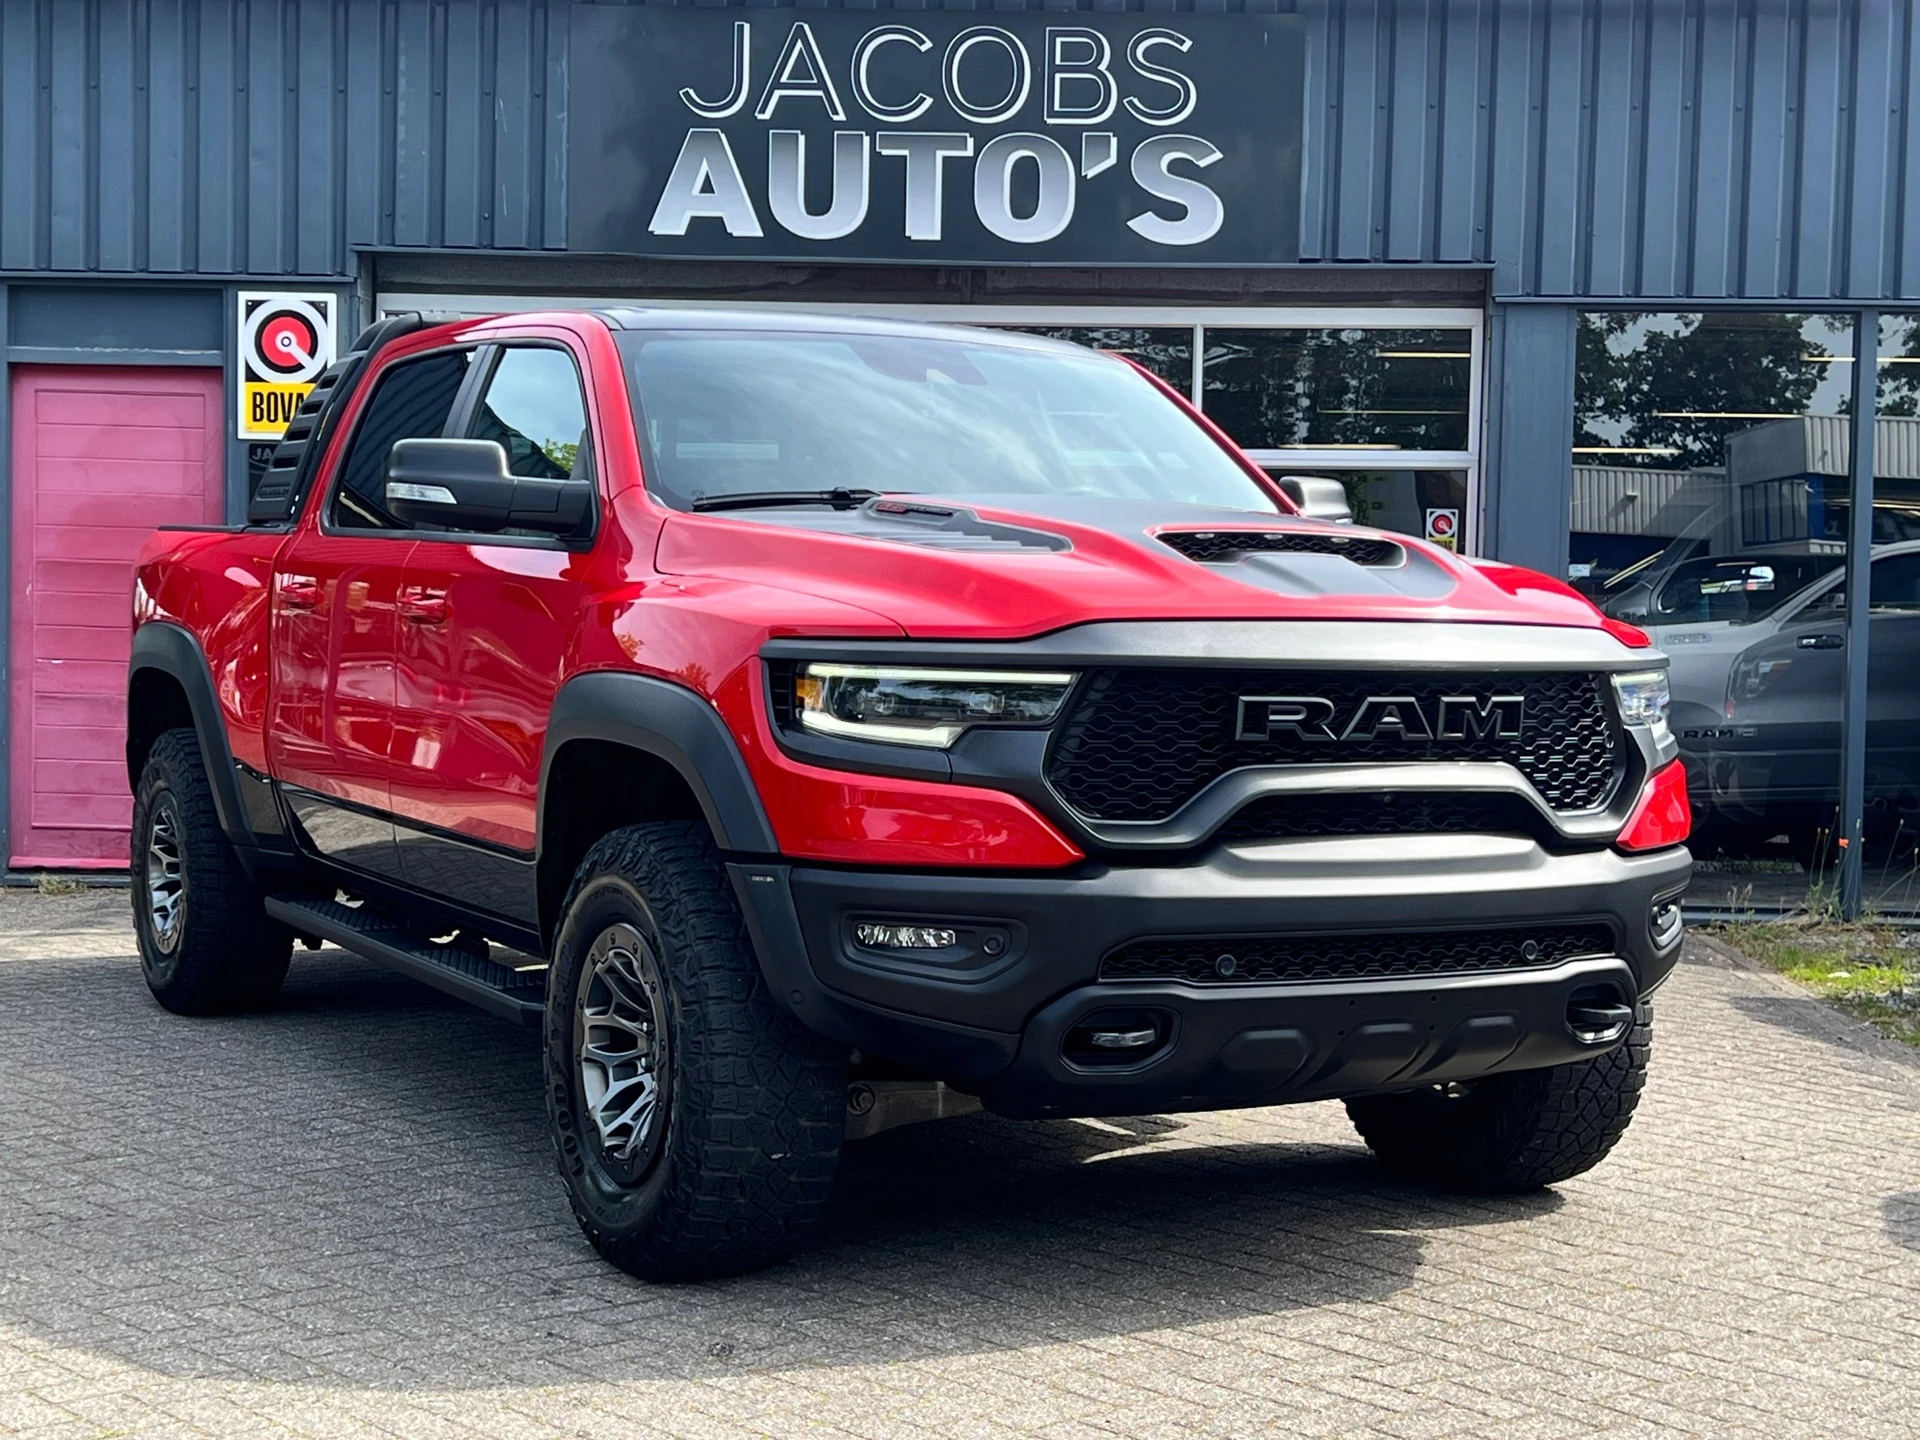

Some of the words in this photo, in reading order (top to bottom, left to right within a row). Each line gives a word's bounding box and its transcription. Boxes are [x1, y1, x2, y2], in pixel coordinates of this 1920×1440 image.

[679, 22, 1196, 126] JACOBS
[648, 128, 1224, 245] AUTO'S
[1235, 695, 1525, 741] RAM
[1682, 729, 1733, 738] RAM
